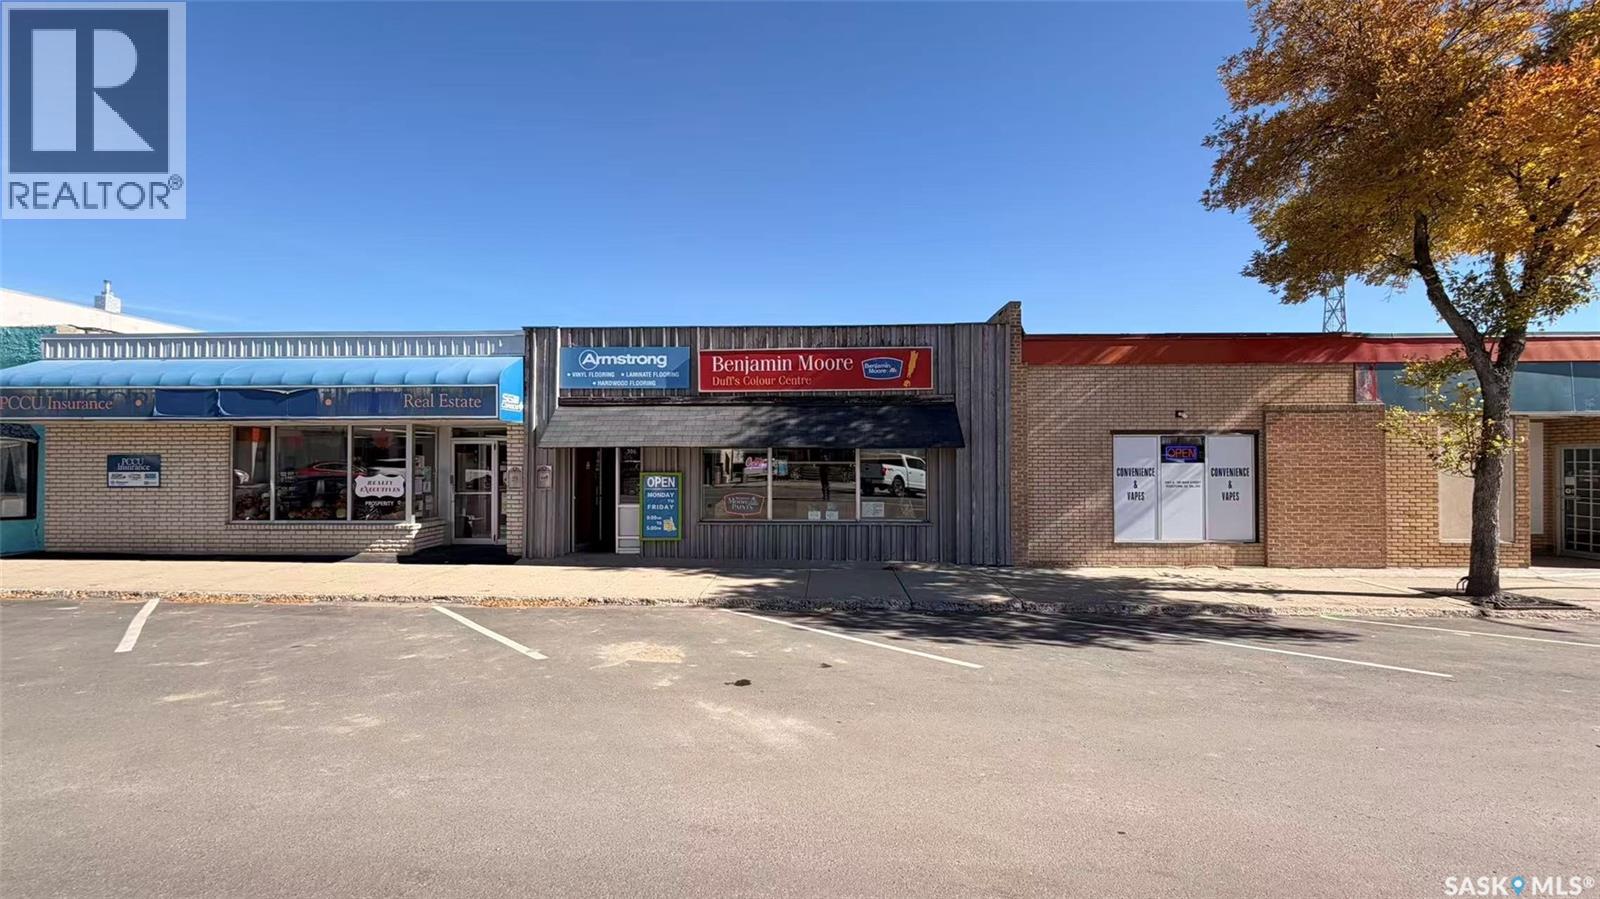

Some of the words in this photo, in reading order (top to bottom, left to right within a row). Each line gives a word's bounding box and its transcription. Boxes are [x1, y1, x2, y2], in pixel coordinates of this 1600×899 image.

[580, 352, 668, 369] Armstrong
[711, 355, 793, 375] Benjamin
[798, 354, 853, 371] Moore
[712, 376, 740, 386] Duff's
[743, 375, 776, 386] Colour
[778, 376, 812, 385] Centre
[0, 395, 43, 410] PCCU
[47, 395, 113, 410] Insurance
[403, 393, 434, 408] Real
[438, 393, 482, 408] Estate
[1167, 448, 1196, 458] OPEN
[117, 463, 151, 471] Insurance
[1116, 467, 1155, 477] CONVENIENCE
[1210, 467, 1250, 477] CONVENIENCE
[647, 476, 675, 488] OPEN
[1133, 480, 1138, 489] &
[1228, 480, 1233, 489] &
[1127, 491, 1145, 501] VAPES
[1221, 491, 1240, 501] VAPES
